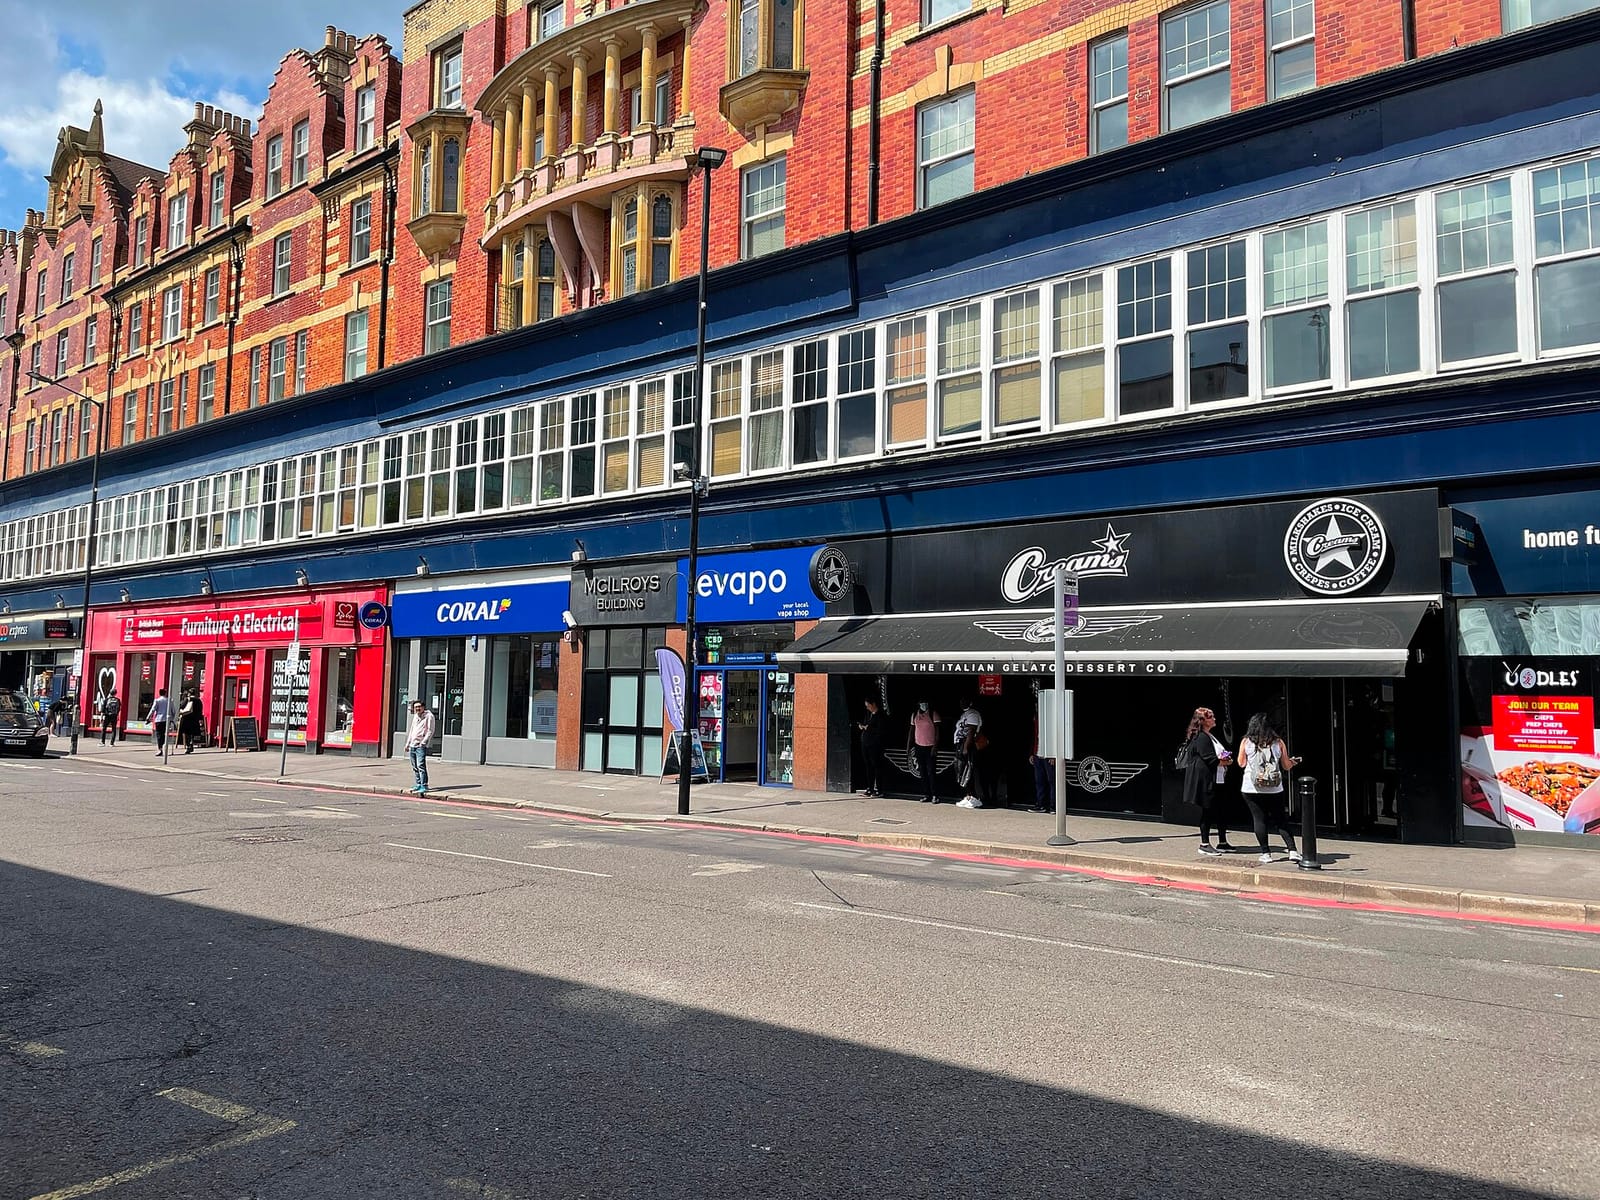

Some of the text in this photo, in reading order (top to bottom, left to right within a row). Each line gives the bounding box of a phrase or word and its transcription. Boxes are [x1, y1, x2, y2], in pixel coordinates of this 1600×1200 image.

[1289, 503, 1333, 555] MILKSHAKES
[1340, 503, 1381, 550] ICE CREAM
[1523, 529, 1579, 548] home
[1294, 562, 1330, 589] CREPES
[1338, 557, 1377, 588] COFFEE
[697, 569, 787, 605] evapo
[181, 609, 298, 636] Furniture & Electrical
[436, 600, 500, 623] CORAL
[777, 609, 809, 618] vape shop
[9, 625, 28, 639] express
[912, 663, 1174, 672] THE ITALIAN GELATO DESSERT CO.
[271, 701, 286, 712] 0800
[1507, 701, 1579, 710] JOIN OUR TEAM
